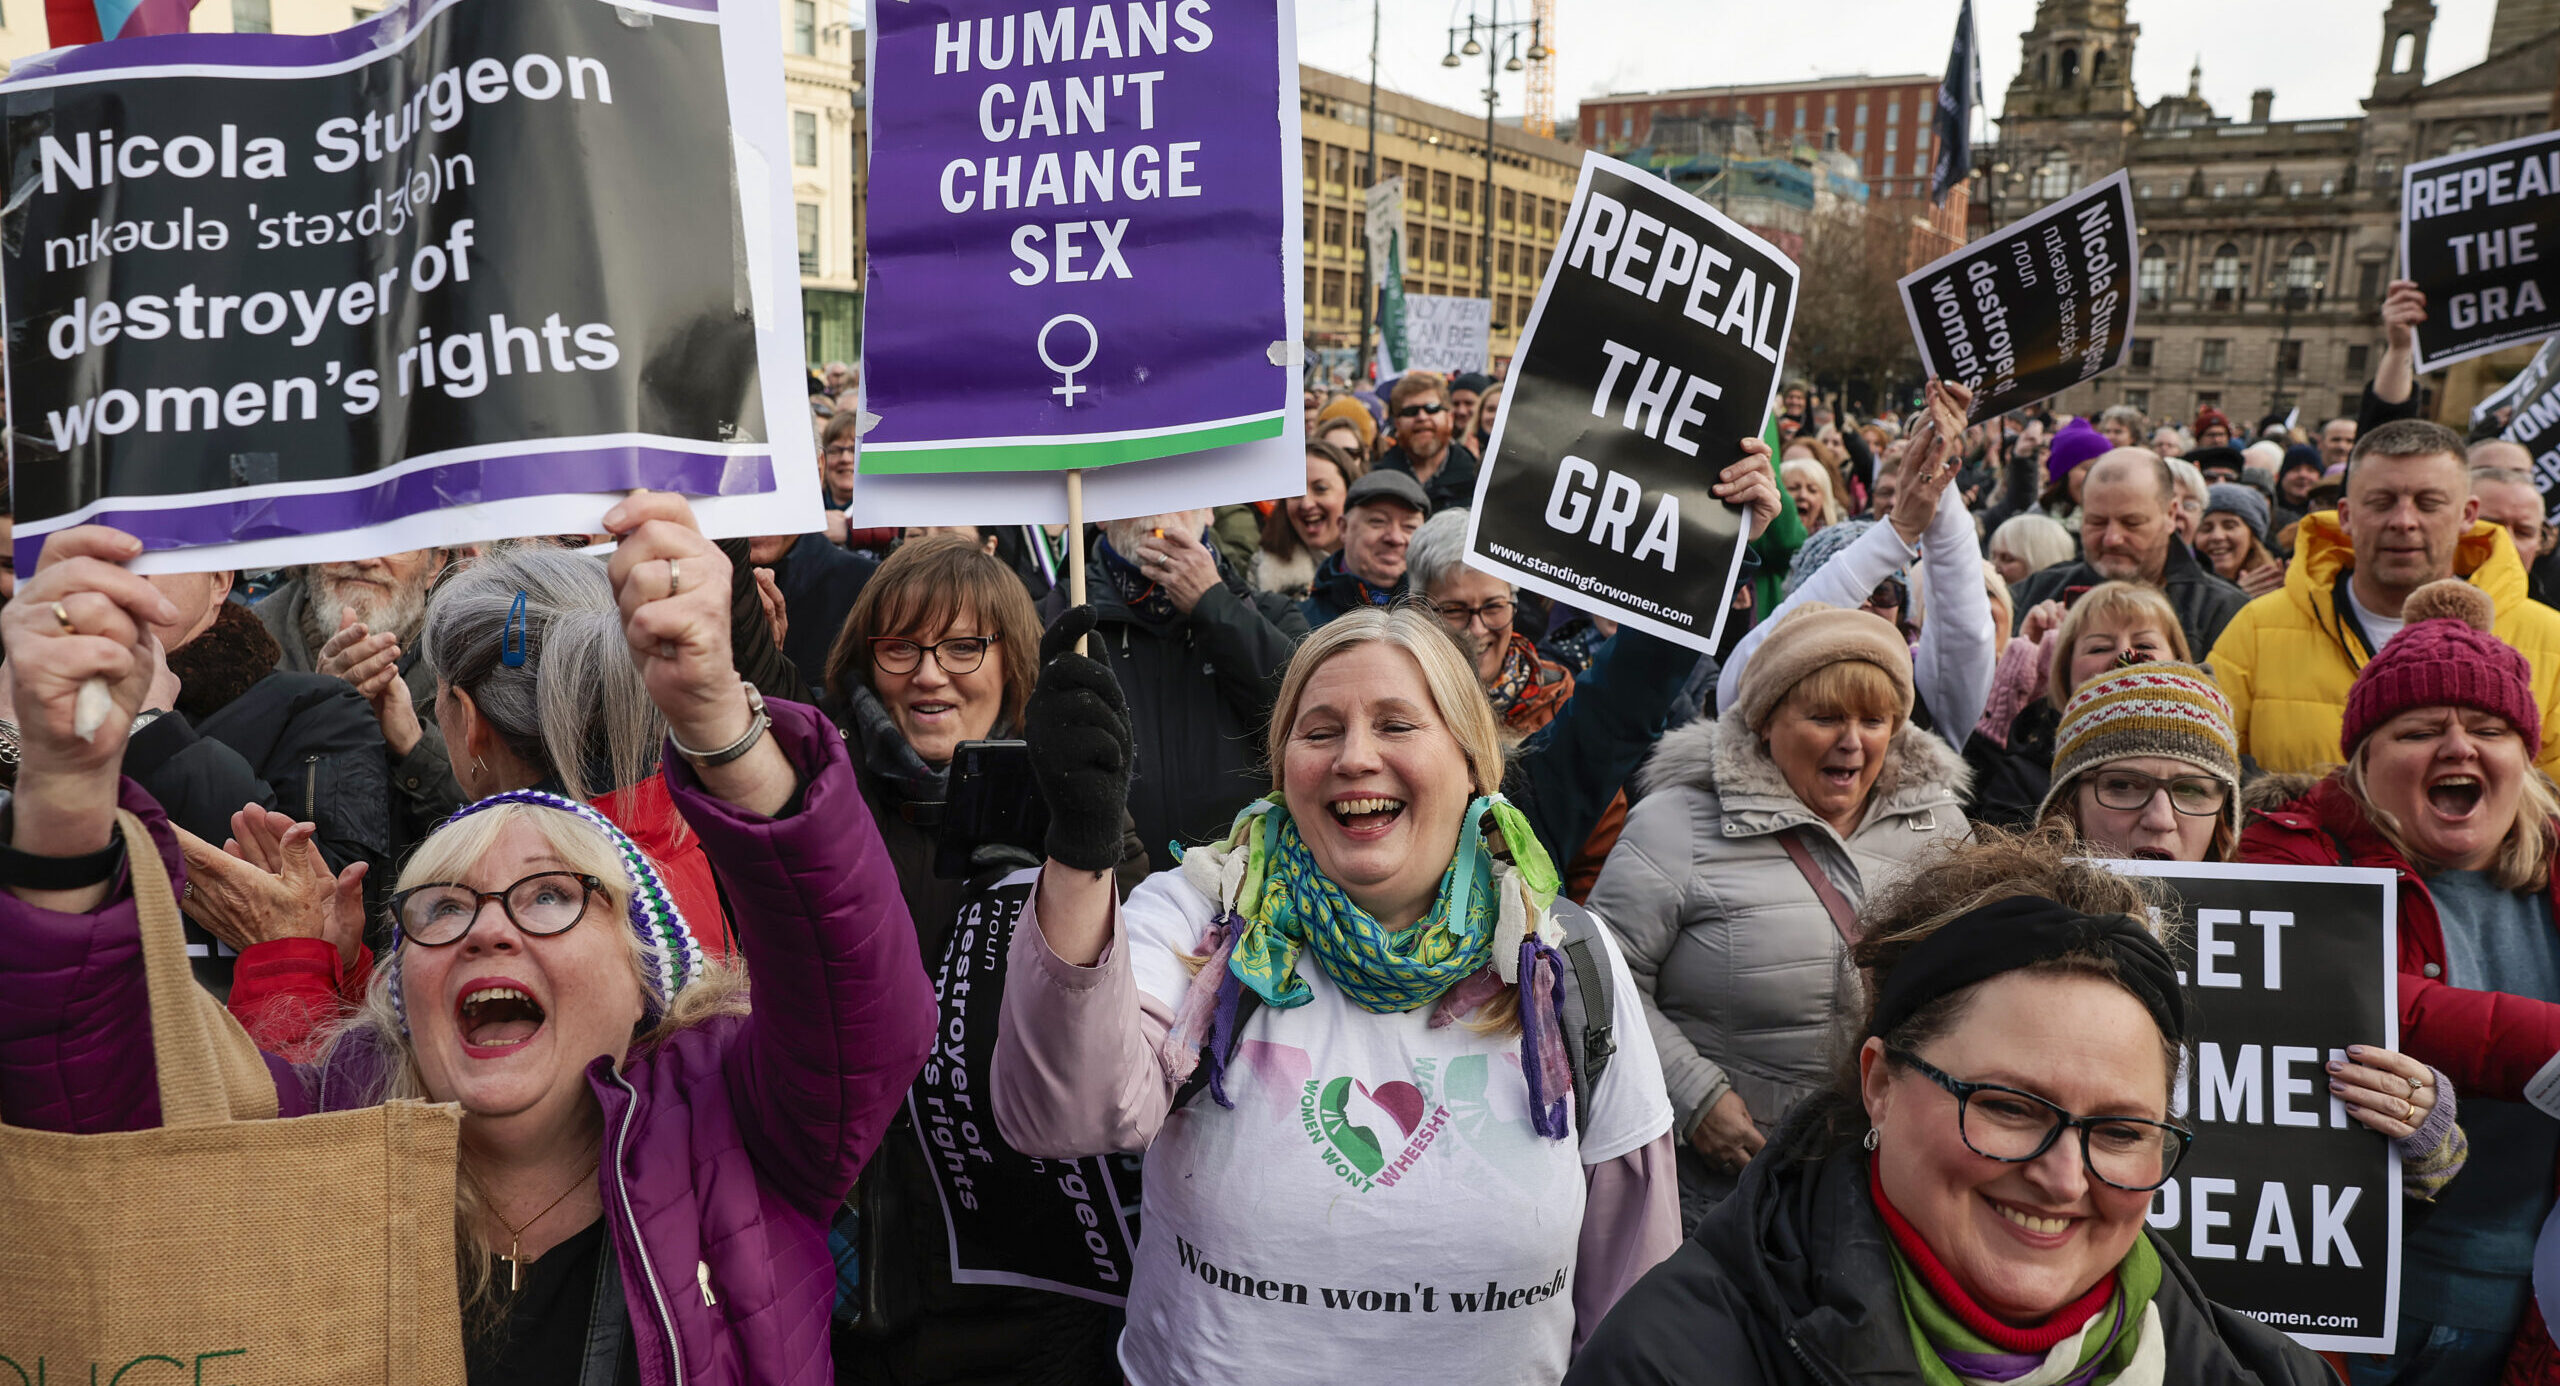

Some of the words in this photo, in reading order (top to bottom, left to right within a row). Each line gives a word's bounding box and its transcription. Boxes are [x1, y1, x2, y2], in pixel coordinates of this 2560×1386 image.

[934, 0, 1214, 75] HUMANS
[39, 124, 287, 194] Nicola
[313, 53, 613, 173] Sturgeon
[979, 70, 1165, 142] CAN'T
[940, 141, 1202, 215] CHANGE
[48, 267, 398, 361] destroyer
[410, 218, 475, 293] of
[1009, 218, 1134, 287] SEX
[1568, 191, 1777, 364] REPEAL
[2011, 240, 2038, 289] noun
[2076, 200, 2119, 298] Nicola
[2447, 222, 2540, 276] THE
[1447, 325, 1475, 348] BE
[1967, 259, 2018, 380] destroyer
[2449, 279, 2547, 331] GRA
[47, 361, 380, 453] women’s
[398, 312, 621, 398] rights
[1591, 339, 1723, 457] THE
[1544, 455, 1680, 572] GRA
[1489, 541, 1694, 626] www.standingforwomen.com
[984, 899, 1004, 972] noun
[944, 902, 982, 1112] destroyer
[928, 1097, 979, 1212] rights
[961, 1120, 993, 1163] of
[1300, 1079, 1325, 1145] WOMEN
[1376, 1104, 1452, 1188] WHEESHT
[2146, 1175, 2363, 1268] PEAK
[1175, 1234, 1309, 1305] Women
[1320, 1282, 1440, 1313] won't
[1448, 1264, 1569, 1313] wheesht
